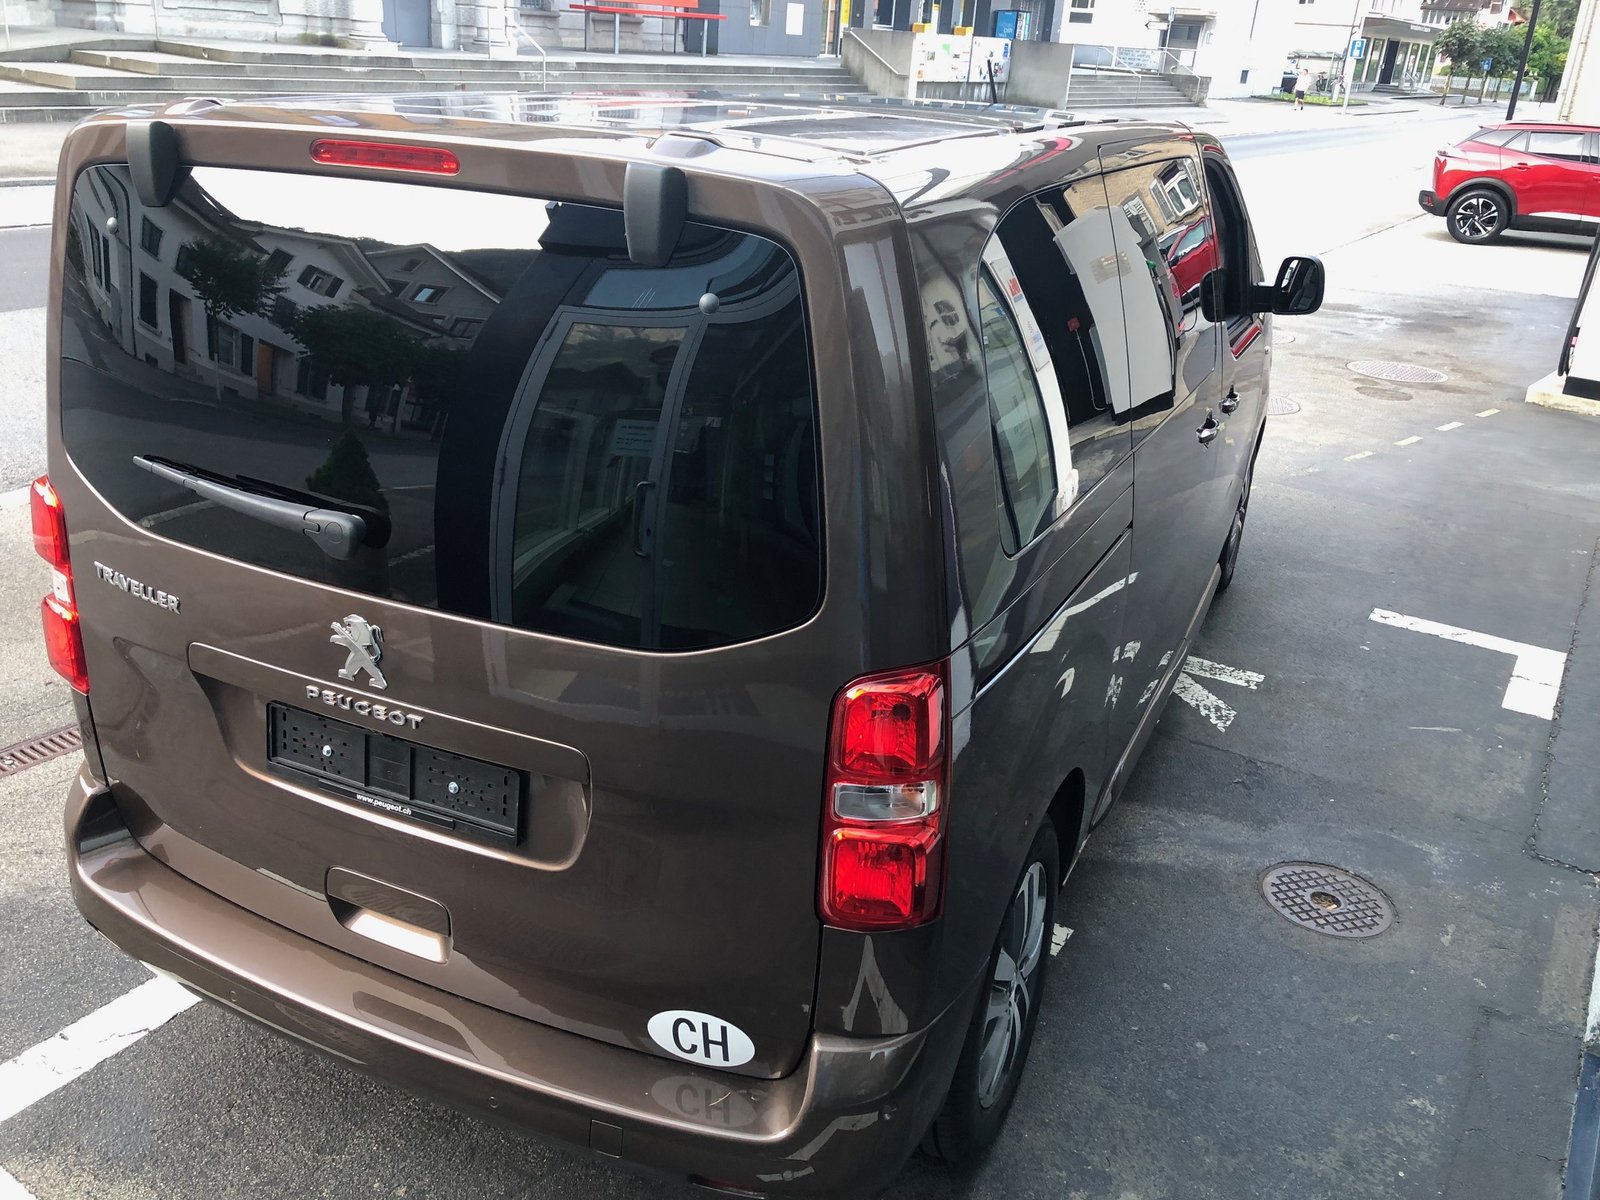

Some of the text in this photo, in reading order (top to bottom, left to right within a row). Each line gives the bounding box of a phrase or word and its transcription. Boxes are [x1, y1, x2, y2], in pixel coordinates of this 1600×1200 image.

[94, 561, 181, 615] TRAVELLER
[306, 684, 425, 730] PEUGEOT
[356, 793, 412, 816] www.peugeot.ch
[672, 1017, 730, 1062] CH
